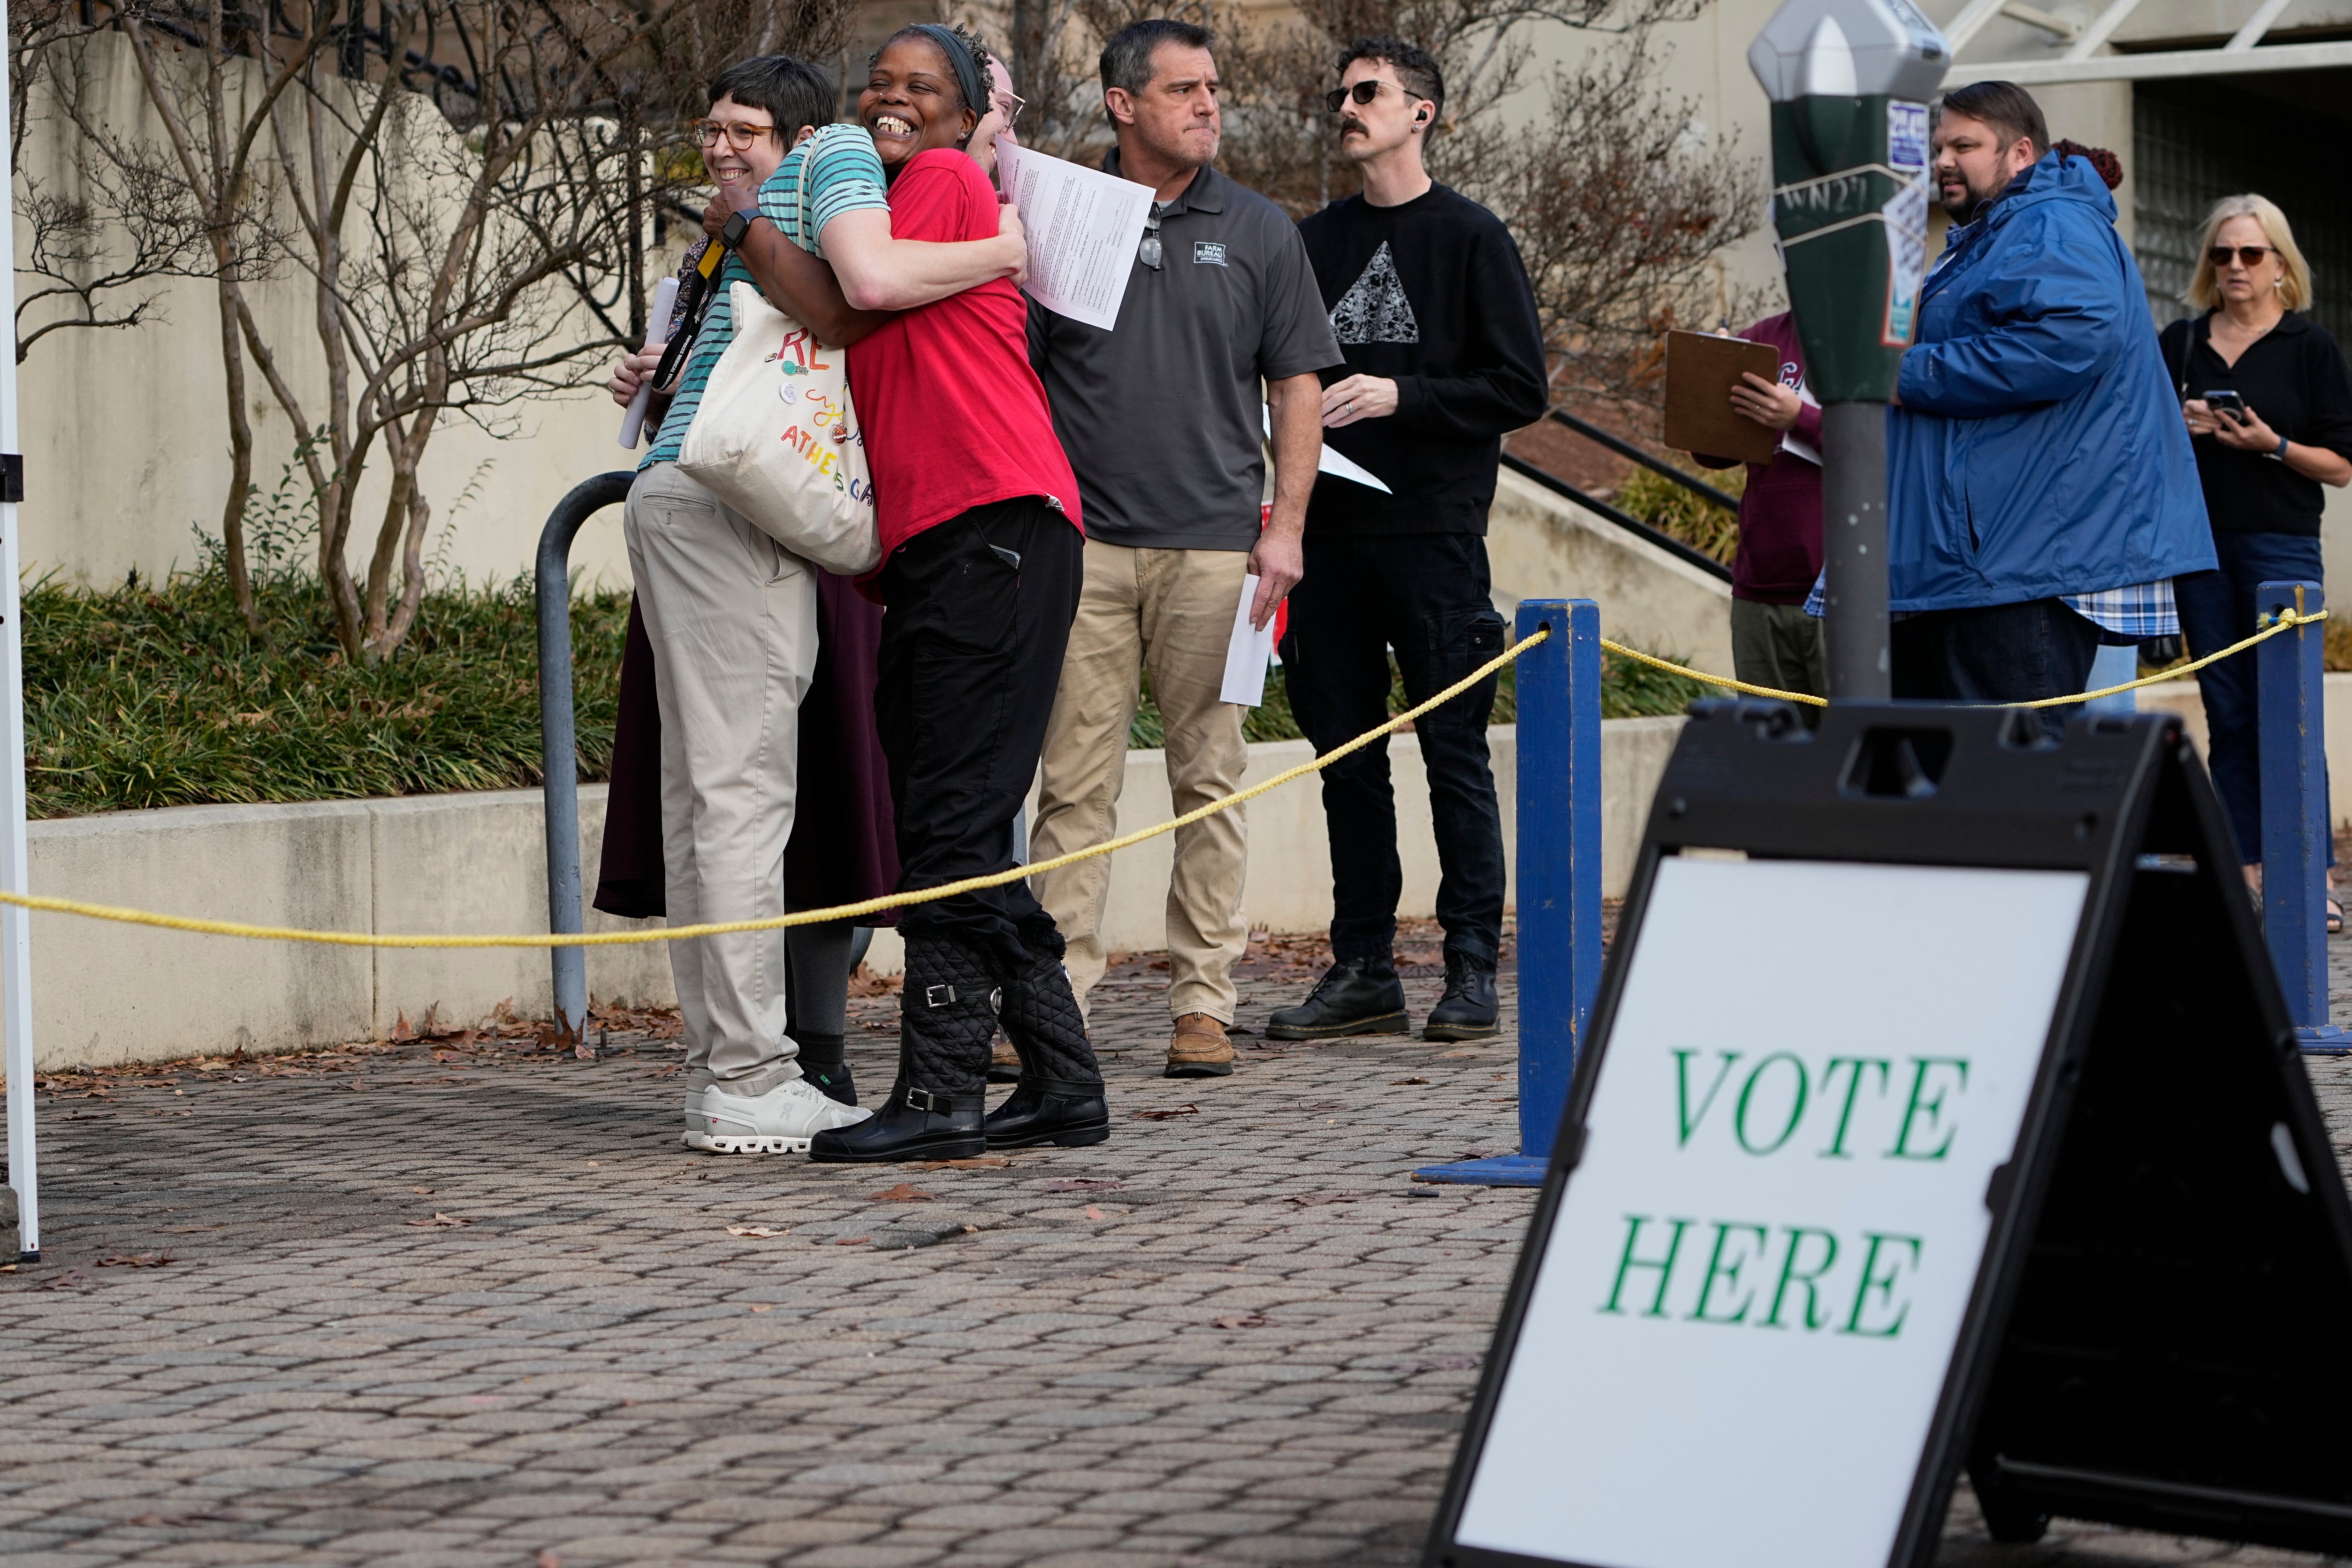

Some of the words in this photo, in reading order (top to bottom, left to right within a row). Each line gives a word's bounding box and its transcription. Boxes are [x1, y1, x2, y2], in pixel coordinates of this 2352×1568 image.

[670, 354, 682, 373] MEDICAL
[680, 335, 693, 355] EXPRESS
[1669, 1047, 1971, 1162] VOTE
[1596, 1214, 1924, 1340] HERE
